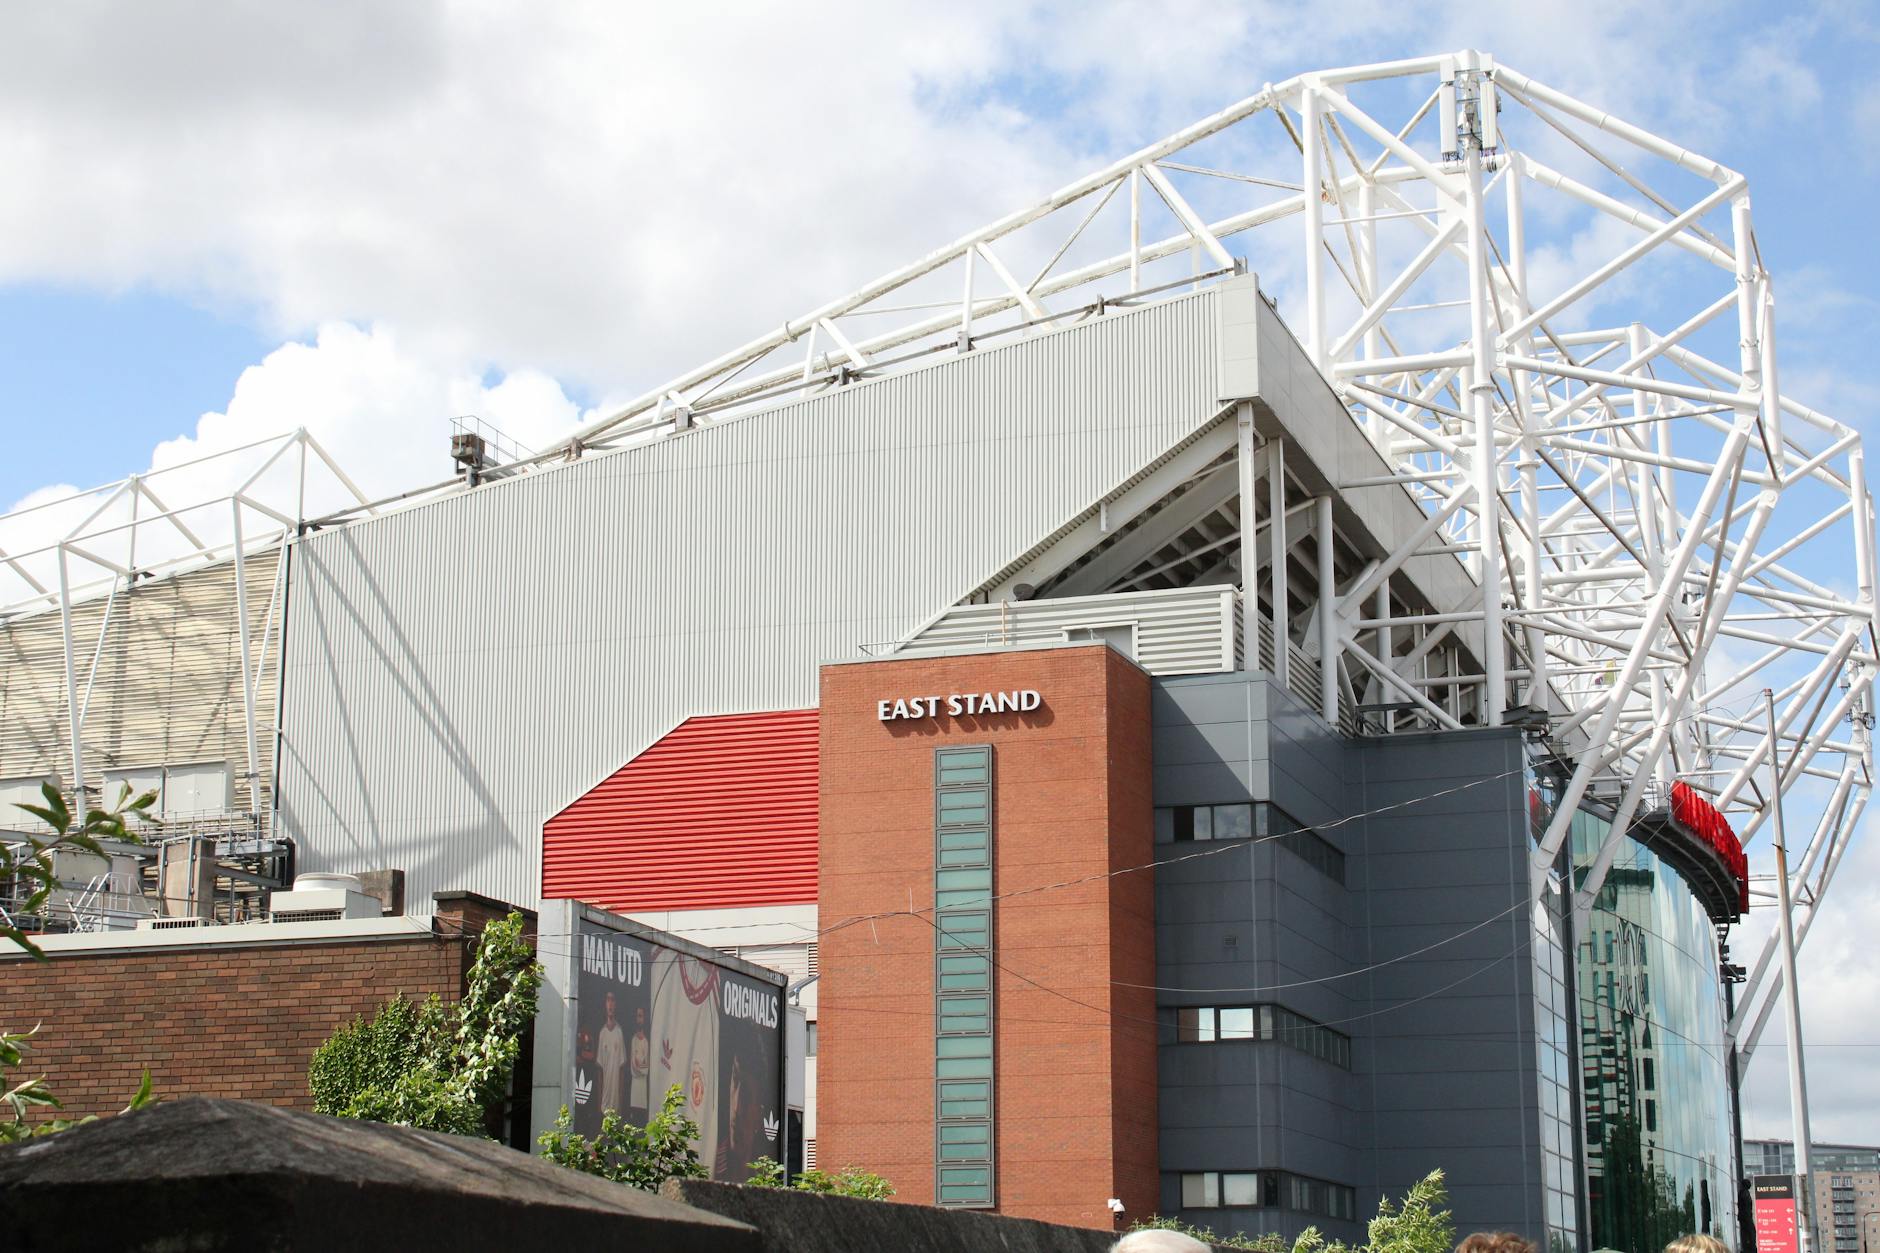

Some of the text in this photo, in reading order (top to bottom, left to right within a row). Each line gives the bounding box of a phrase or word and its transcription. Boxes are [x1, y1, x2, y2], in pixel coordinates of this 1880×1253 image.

[878, 690, 1041, 720] EAST STAND
[583, 934, 642, 987] MAN UTD
[723, 980, 778, 1029] ORIGINALS
